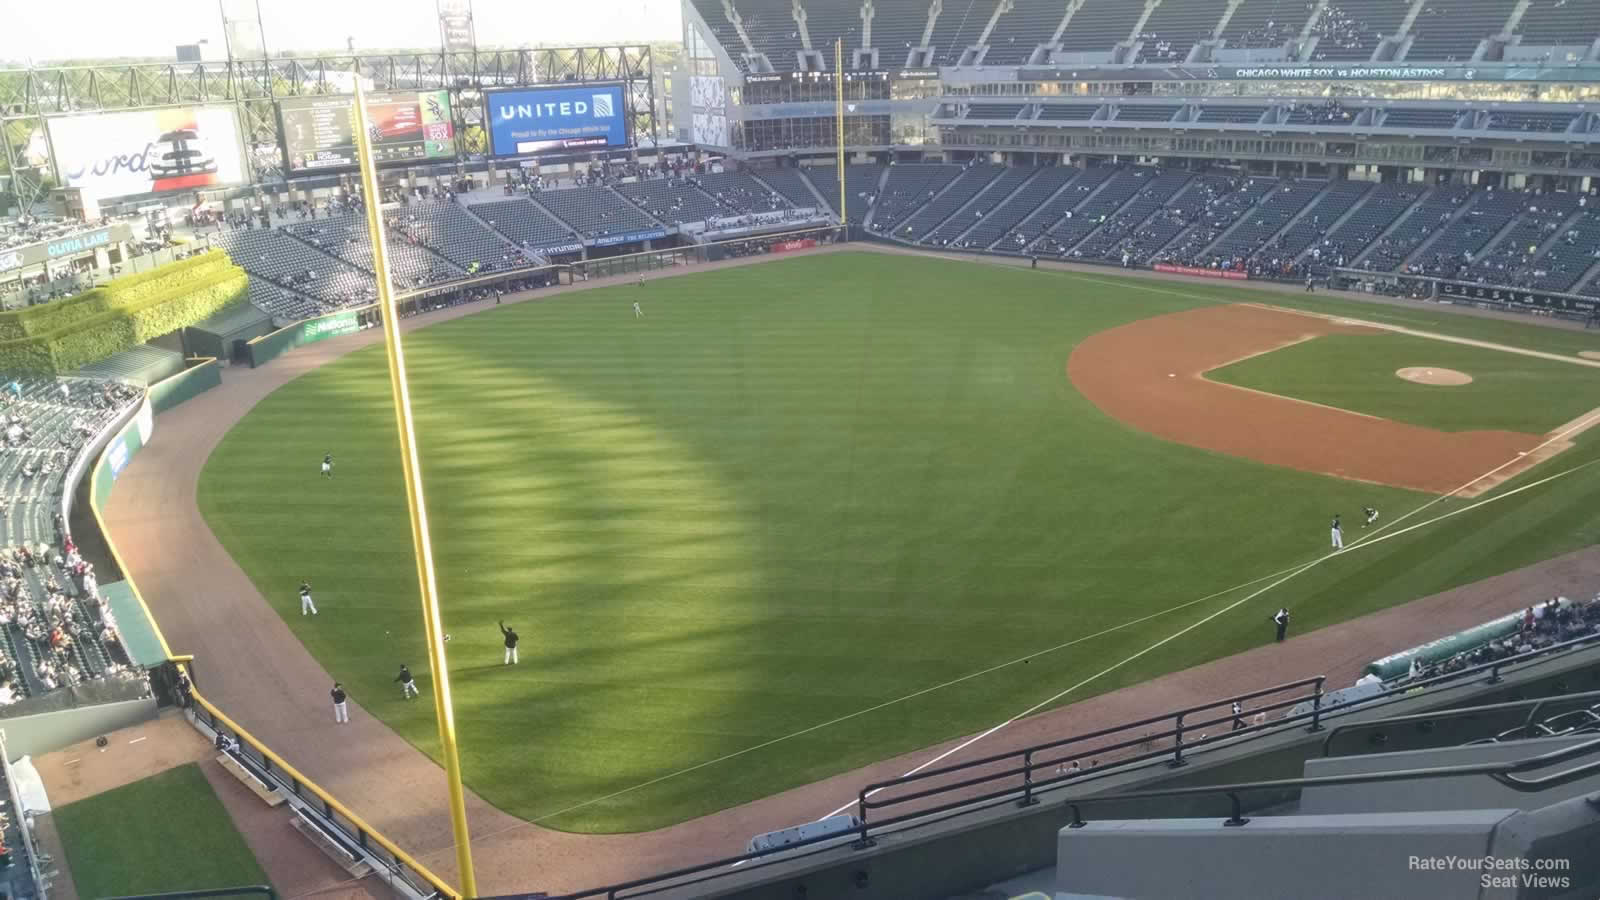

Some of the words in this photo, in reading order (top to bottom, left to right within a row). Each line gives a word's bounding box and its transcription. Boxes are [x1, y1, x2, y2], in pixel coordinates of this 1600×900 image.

[1236, 68, 1279, 77] CHICAGO
[1281, 68, 1311, 77] WHITE
[1313, 68, 1333, 77] SOX
[1351, 68, 1400, 77] HOUSTON
[1402, 68, 1444, 77] ASTROS
[500, 101, 587, 119] UNITED
[48, 239, 81, 256] OLIVIA
[547, 243, 583, 254] HYUNDAI
